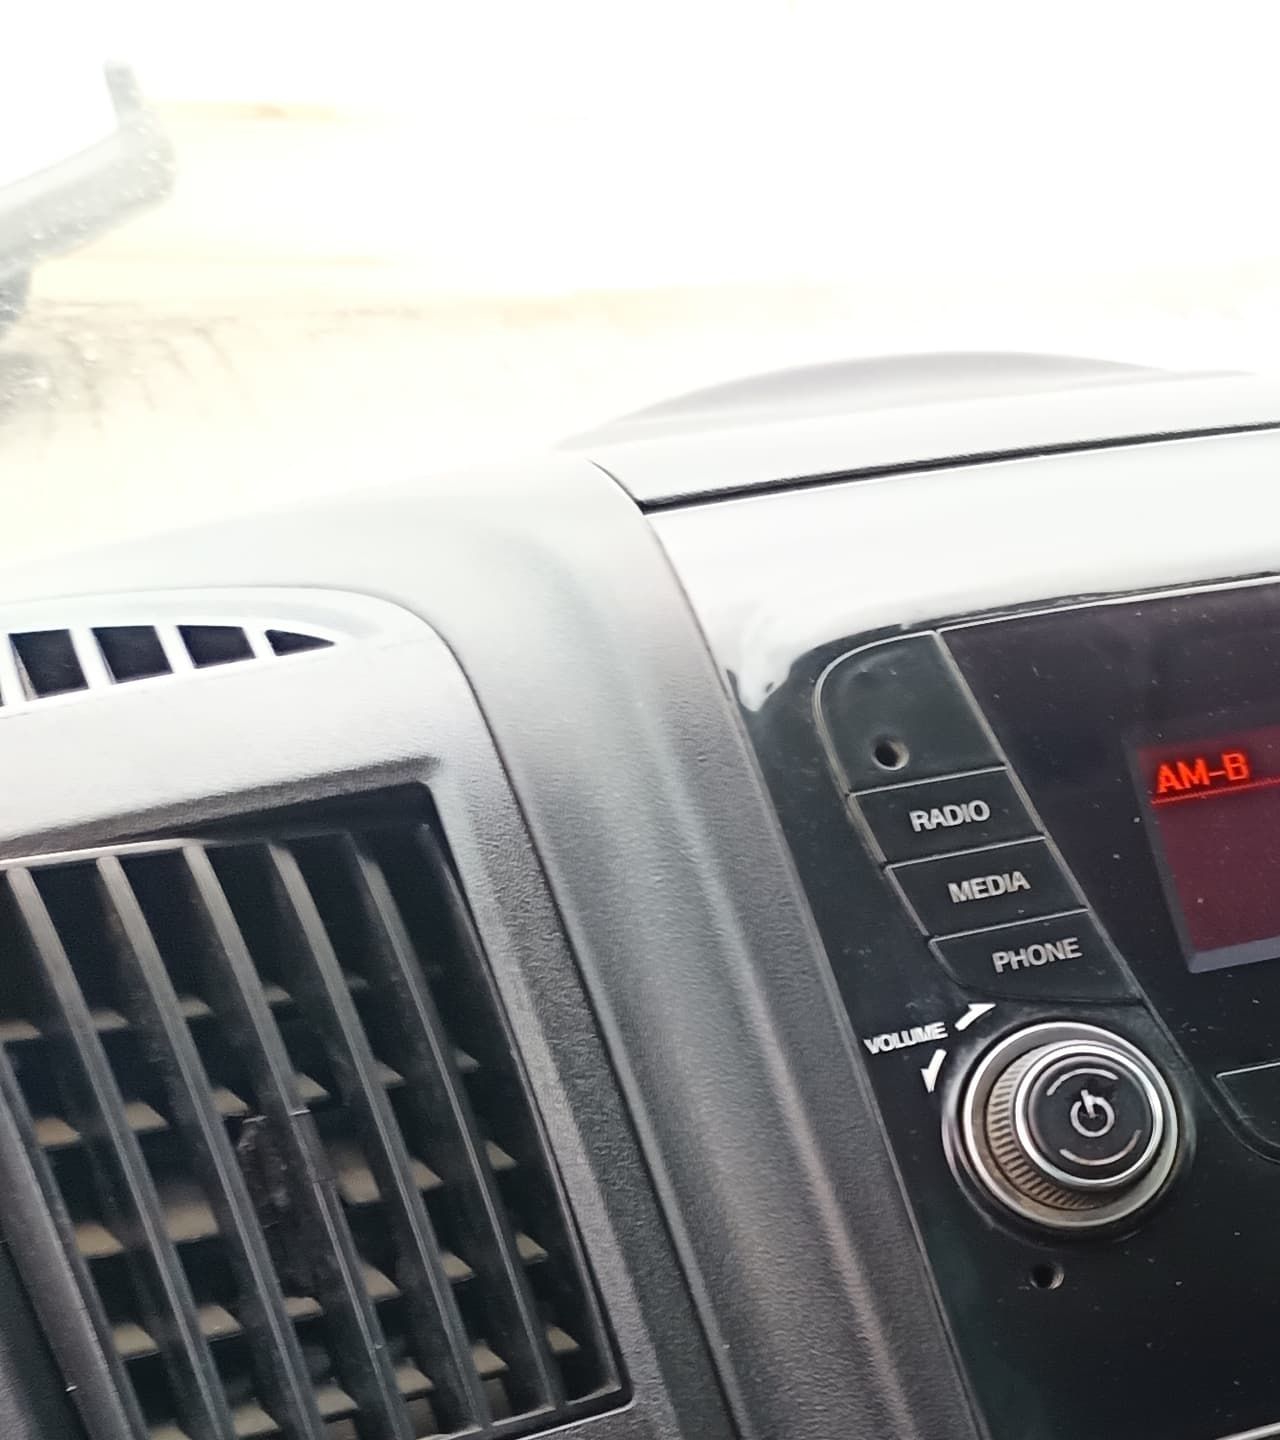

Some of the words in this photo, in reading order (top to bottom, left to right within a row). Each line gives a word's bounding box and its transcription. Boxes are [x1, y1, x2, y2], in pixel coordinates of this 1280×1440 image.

[1156, 752, 1250, 795] AM-B
[909, 800, 991, 832] RADIO
[947, 871, 1031, 904] MEDIA
[991, 938, 1083, 973] PHONE
[863, 1022, 948, 1054] VOLUME
